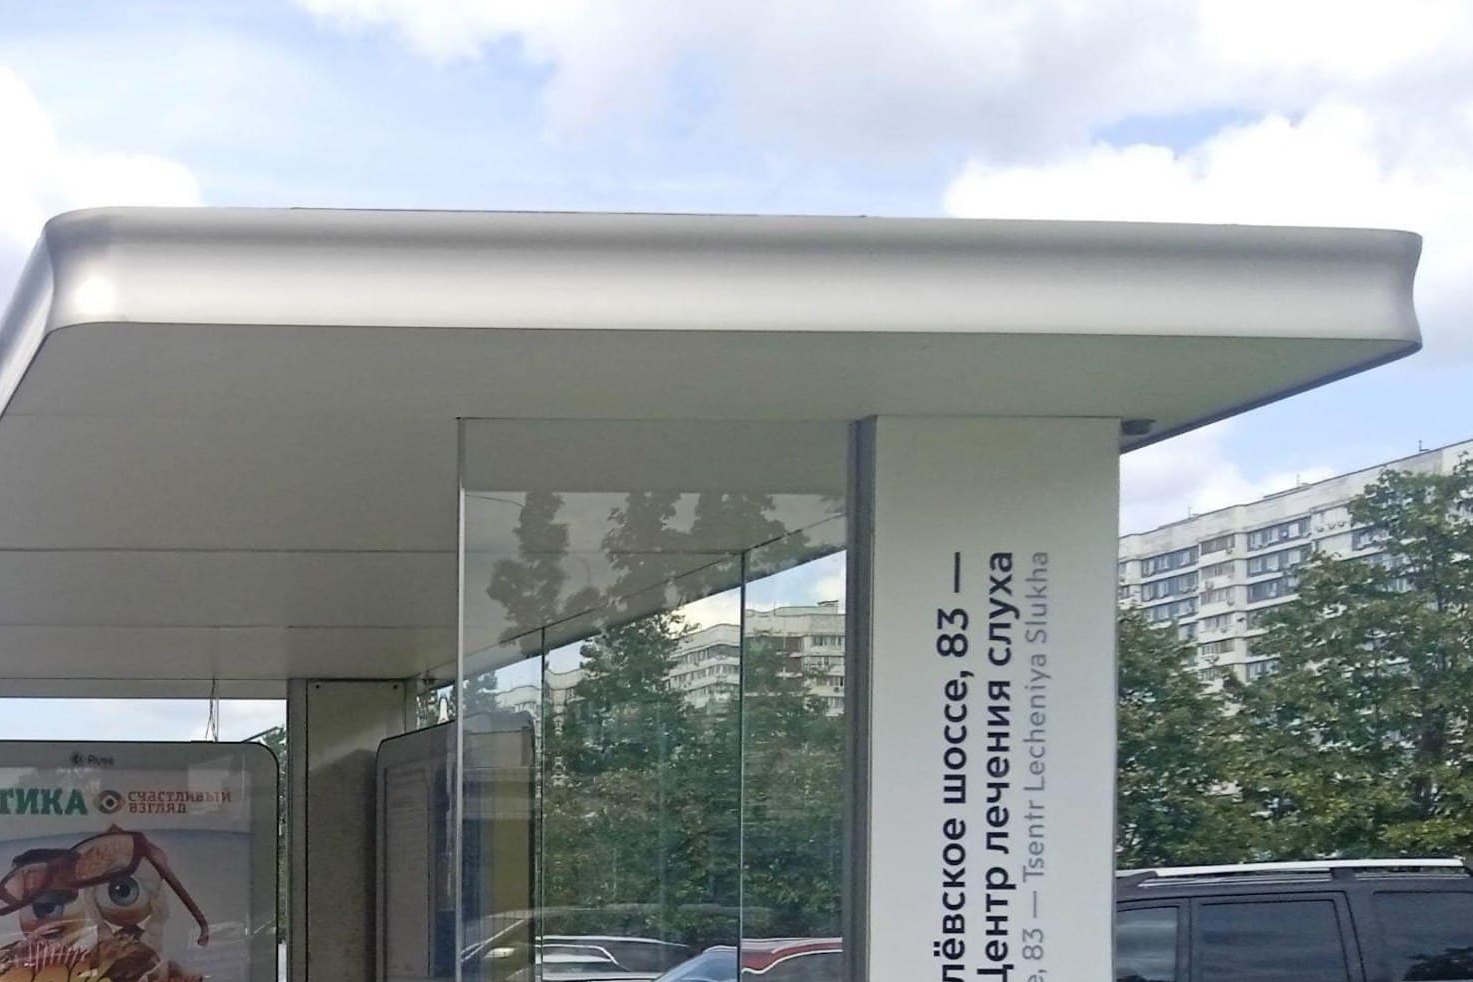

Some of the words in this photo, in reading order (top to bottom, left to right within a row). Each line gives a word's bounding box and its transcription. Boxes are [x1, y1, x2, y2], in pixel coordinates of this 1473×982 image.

[936, 607, 970, 659] 83
[984, 552, 1021, 667] слуха
[1023, 552, 1049, 646] Slukha
[938, 669, 974, 806] шоссе,
[983, 680, 1013, 856] лечения
[1022, 653, 1051, 793] Lecheniya
[1021, 798, 1047, 884] Tsentr
[1021, 926, 1045, 963] 83
